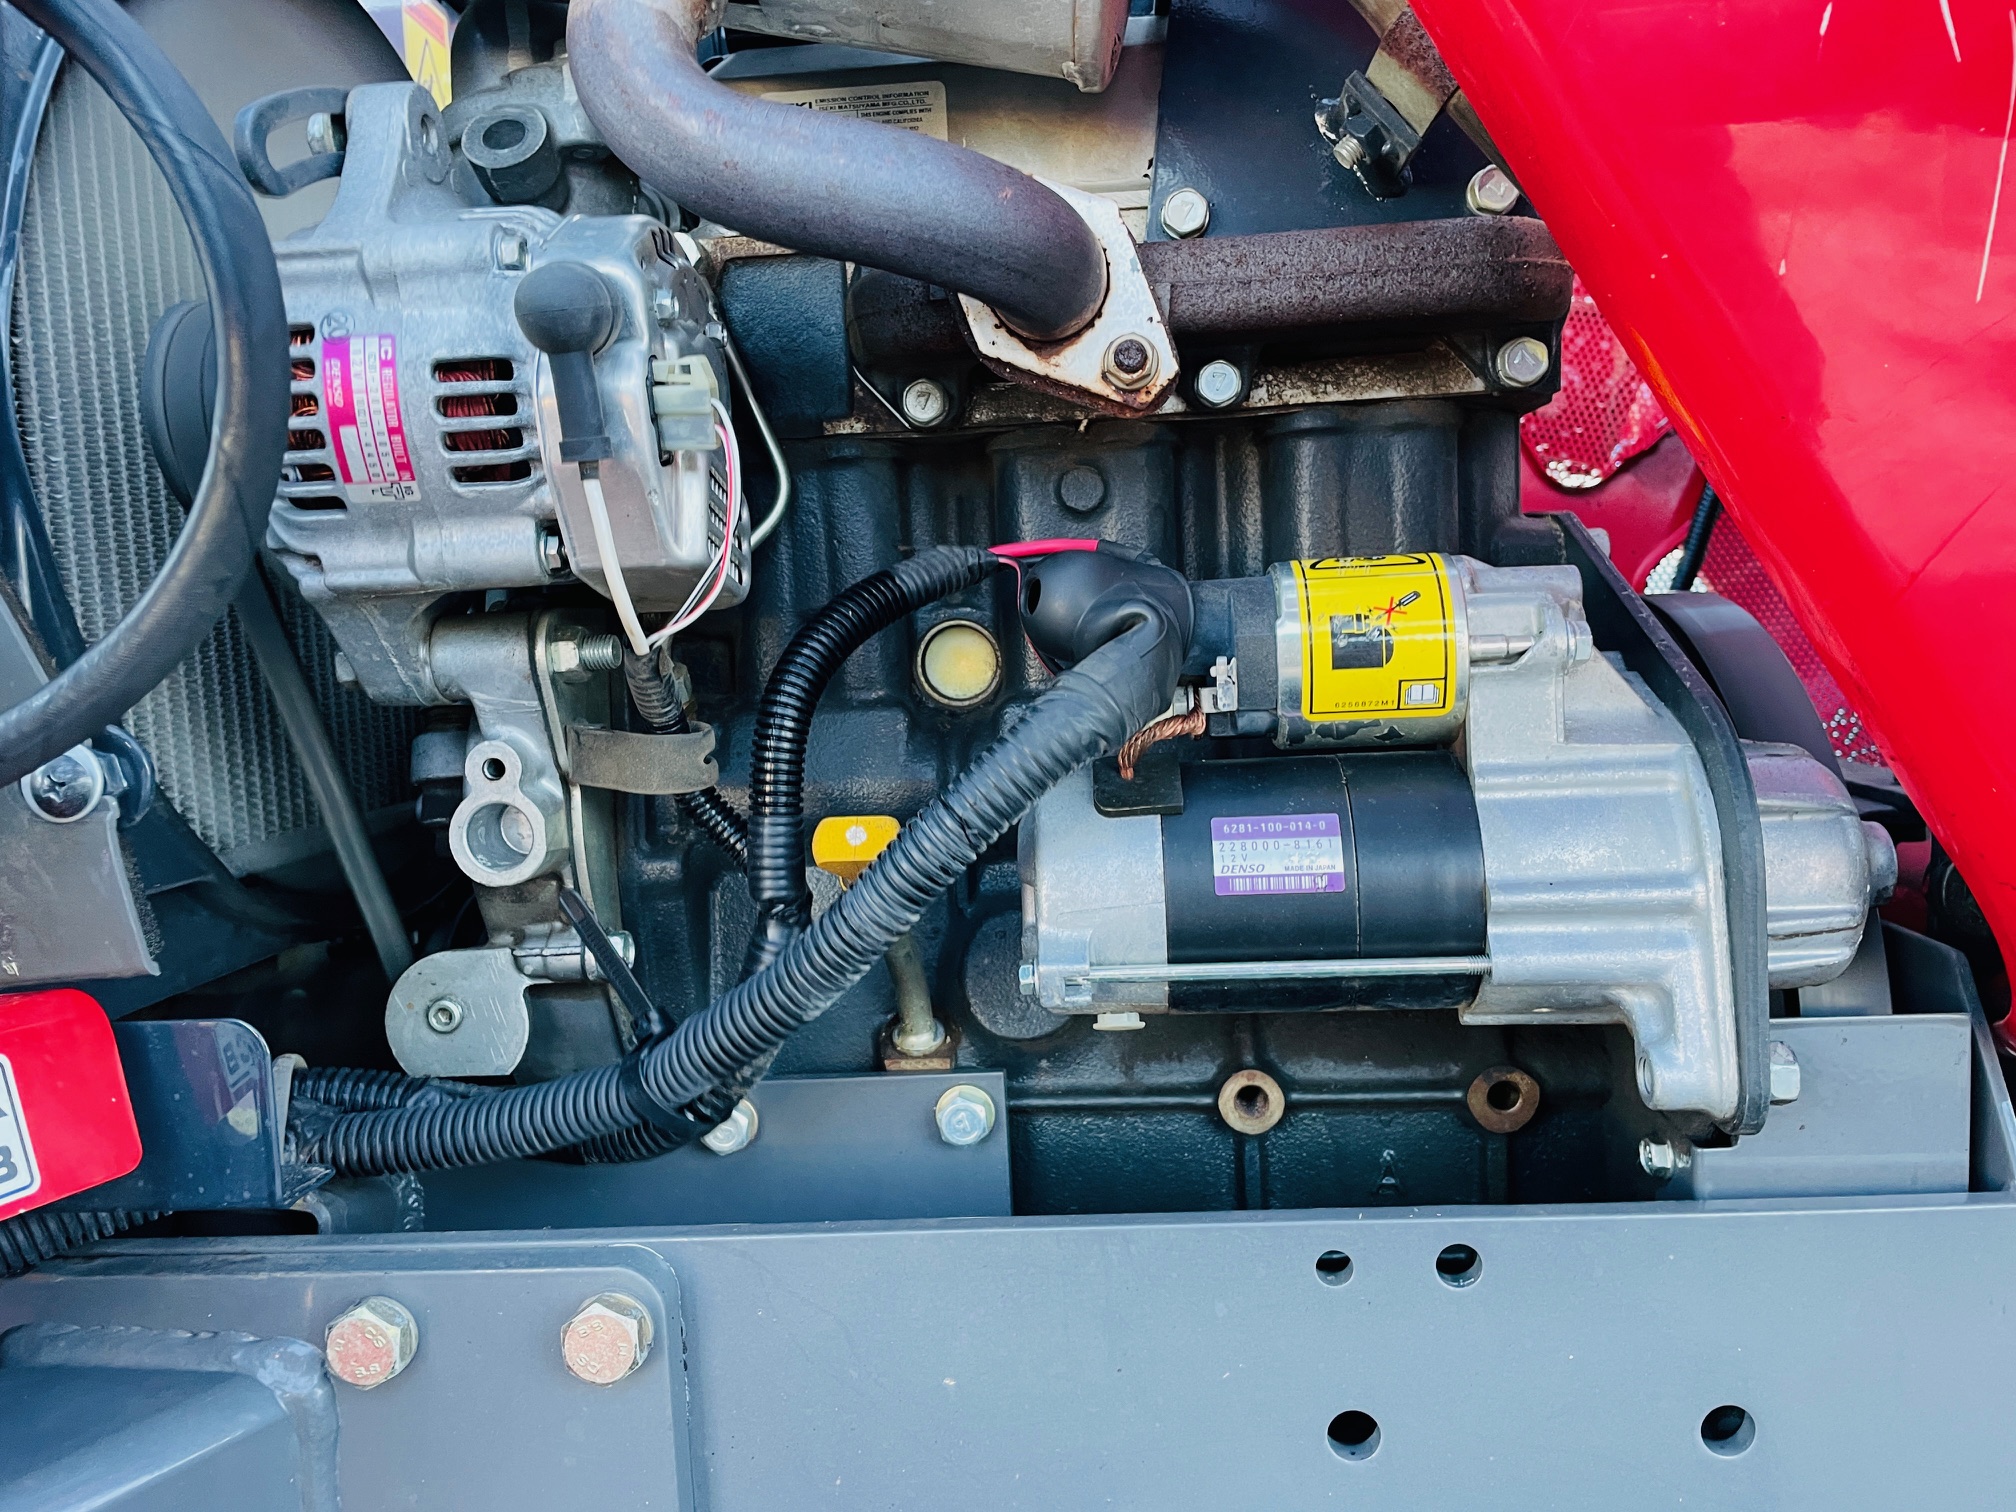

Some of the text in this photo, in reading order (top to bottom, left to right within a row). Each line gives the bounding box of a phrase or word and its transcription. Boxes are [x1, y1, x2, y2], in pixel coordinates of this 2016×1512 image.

[814, 90, 930, 104] EMISSION CONTROL INFORMATION
[838, 101, 880, 110] MATSUYAMA
[390, 434, 408, 464] BUILT
[1223, 820, 1327, 834] 6281-100-014-0
[1218, 838, 1334, 852] 228000-8161
[1220, 854, 1248, 863] 12V
[1220, 863, 1265, 875] DENSO
[1284, 863, 1336, 872] MADE IN JAPAN
